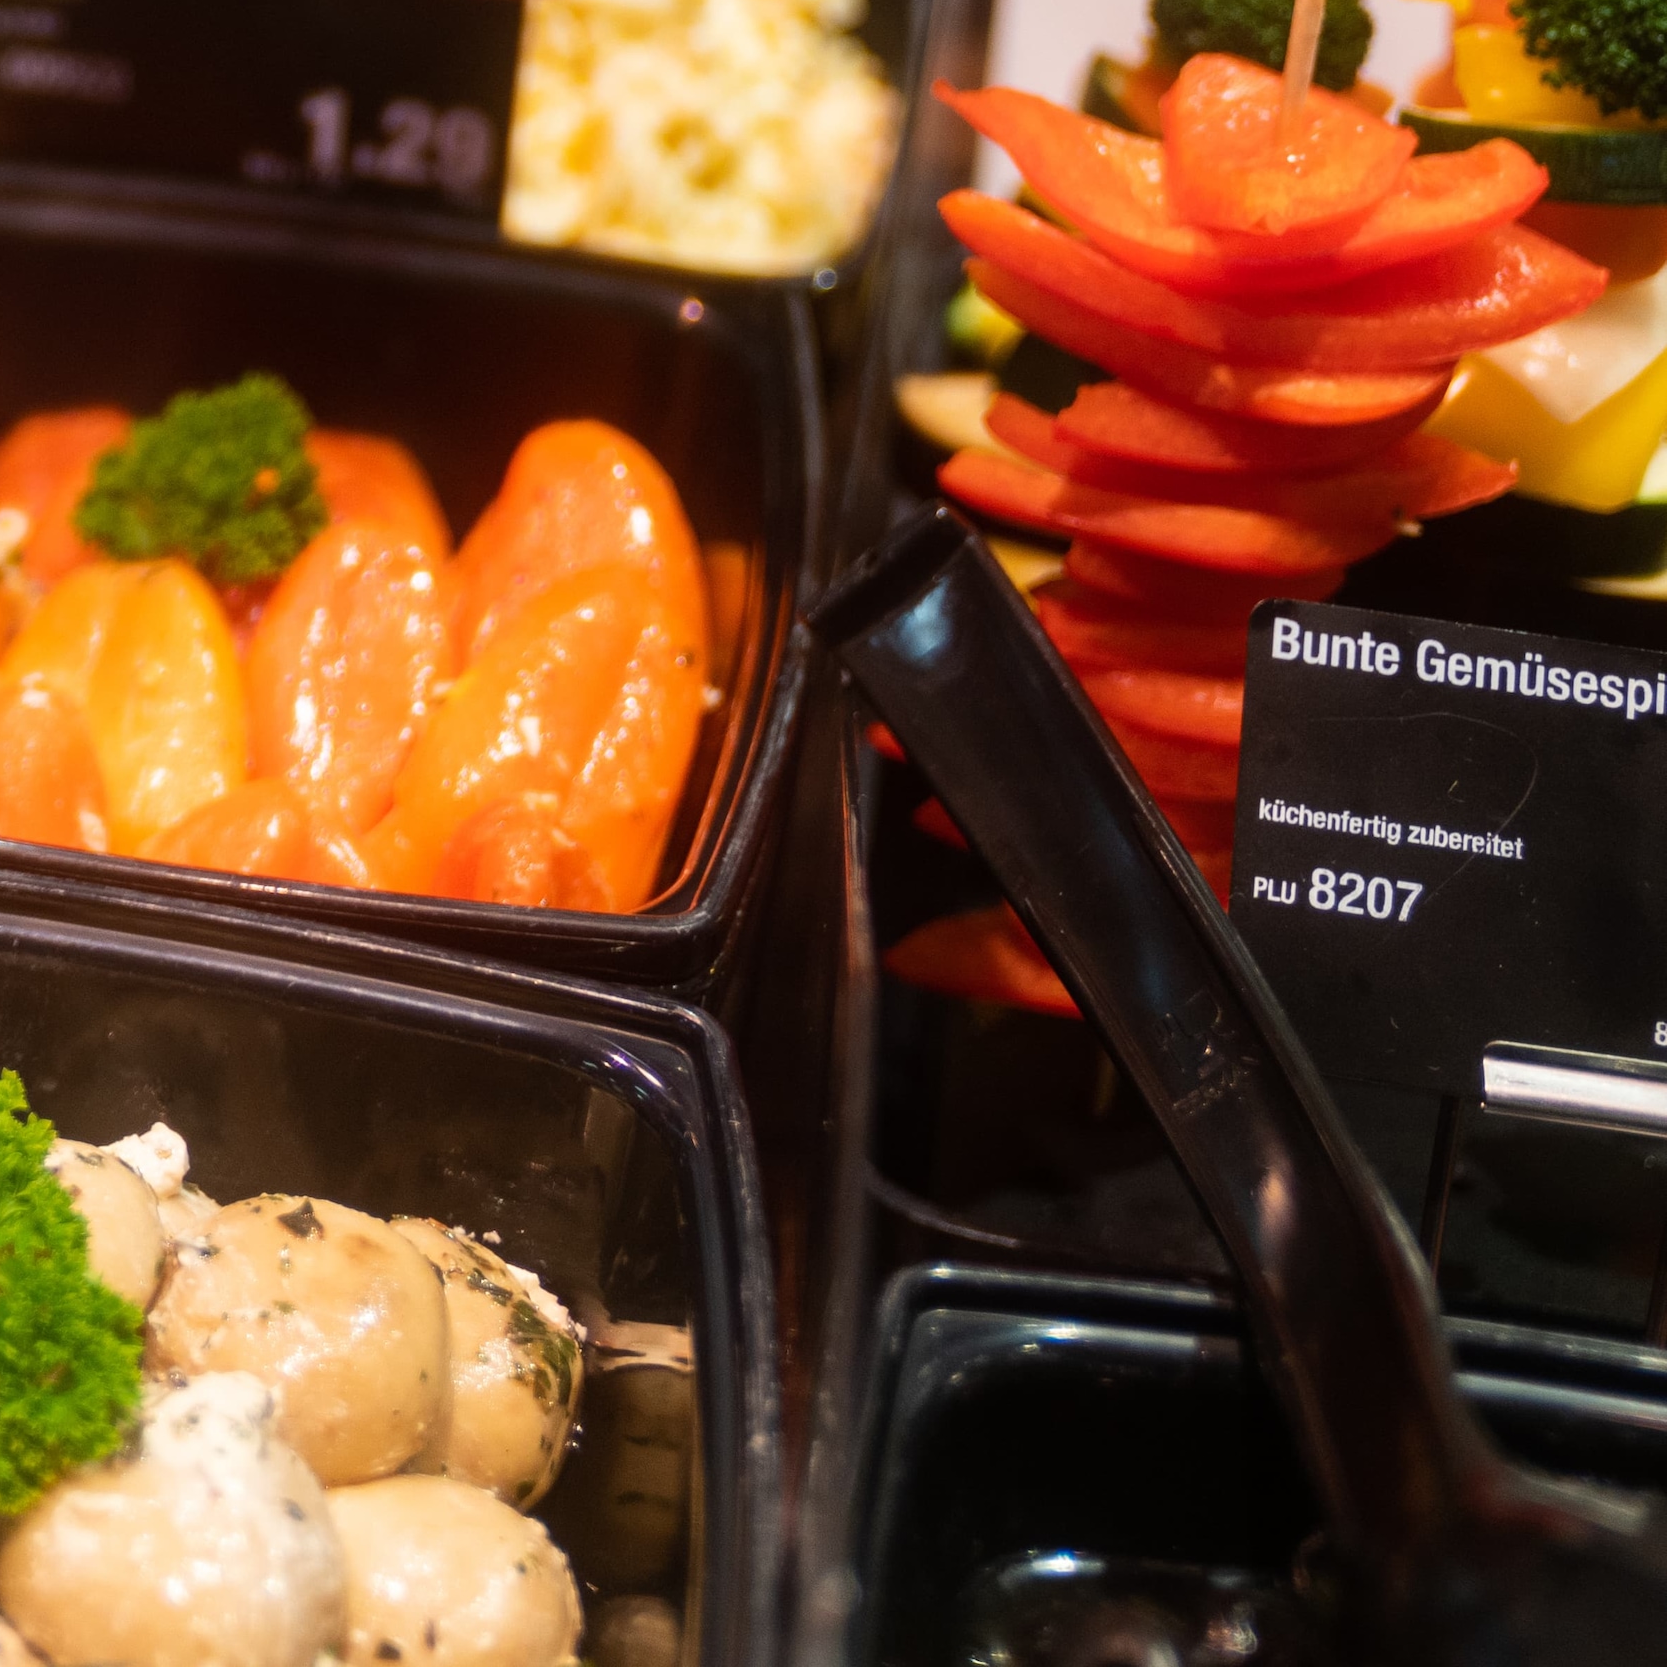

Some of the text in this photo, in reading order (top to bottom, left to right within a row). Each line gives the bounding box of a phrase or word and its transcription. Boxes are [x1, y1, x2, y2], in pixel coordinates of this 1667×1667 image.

[1271, 617, 1667, 721] Bunte Gemüsespi
[1258, 797, 1525, 861] küchenfertig zubereitet
[1253, 867, 1424, 923] PLU 8207
